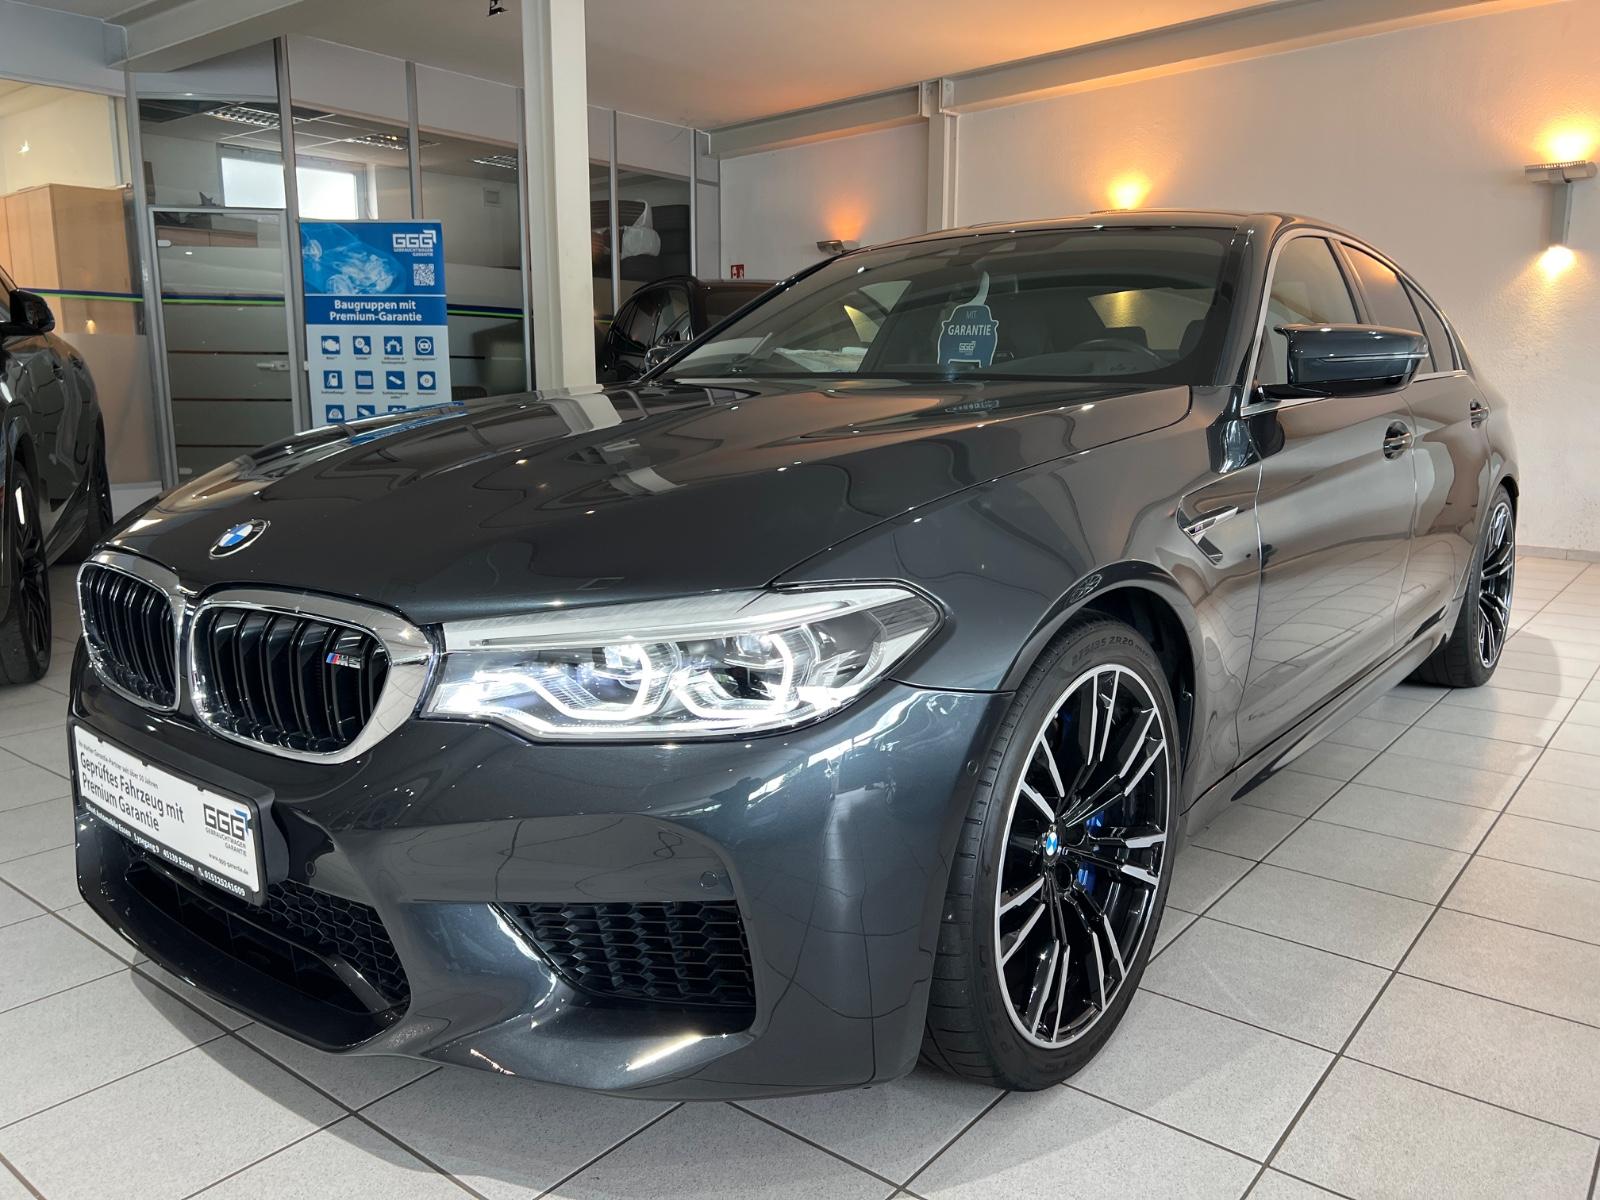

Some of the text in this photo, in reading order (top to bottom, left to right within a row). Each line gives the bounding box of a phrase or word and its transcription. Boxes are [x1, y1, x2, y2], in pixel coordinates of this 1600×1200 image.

[392, 233, 434, 248] GGG
[334, 299, 417, 311] Baugruppen mit
[329, 311, 422, 321] Premium-Garantie
[947, 324, 992, 336] GARANTIE
[1108, 635, 1134, 646] ZR20
[80, 751, 184, 823] Geprüftes Fahrzeug mit
[82, 772, 159, 831] Premium Garantie
[203, 803, 246, 842] GGG
[178, 856, 195, 872] Essen
